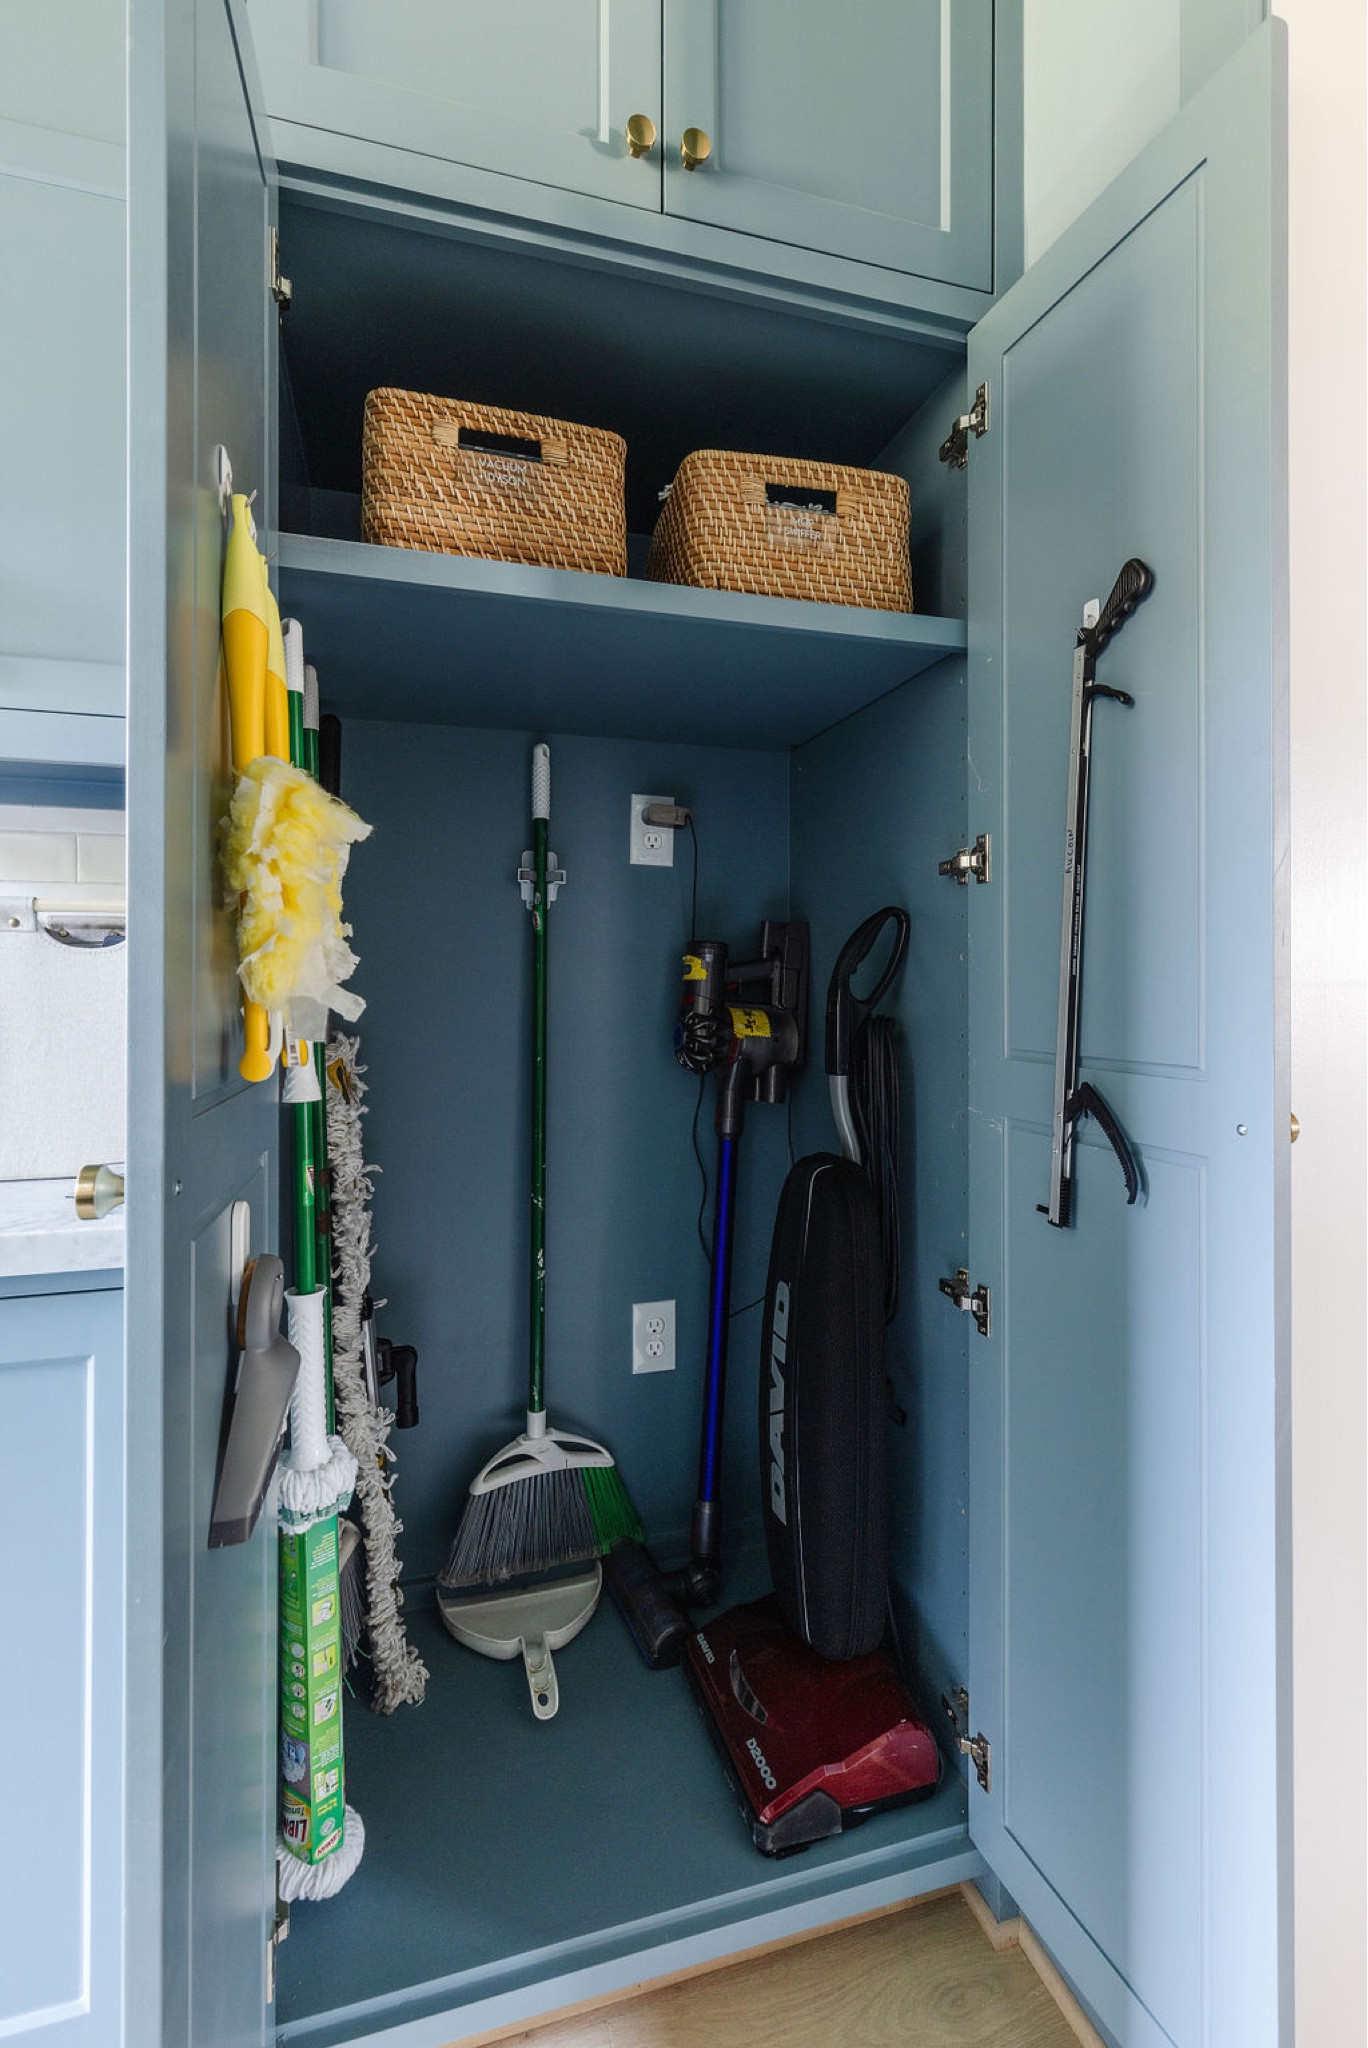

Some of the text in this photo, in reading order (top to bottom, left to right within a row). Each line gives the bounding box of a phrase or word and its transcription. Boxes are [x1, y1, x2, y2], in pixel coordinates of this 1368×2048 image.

[478, 458, 527, 474] VACUUM
[487, 471, 526, 487] DYSON
[792, 517, 815, 527] MOP
[785, 526, 821, 540] SWIFFER
[769, 1279, 791, 1527] DAVID
[746, 1737, 777, 1790] D2000
